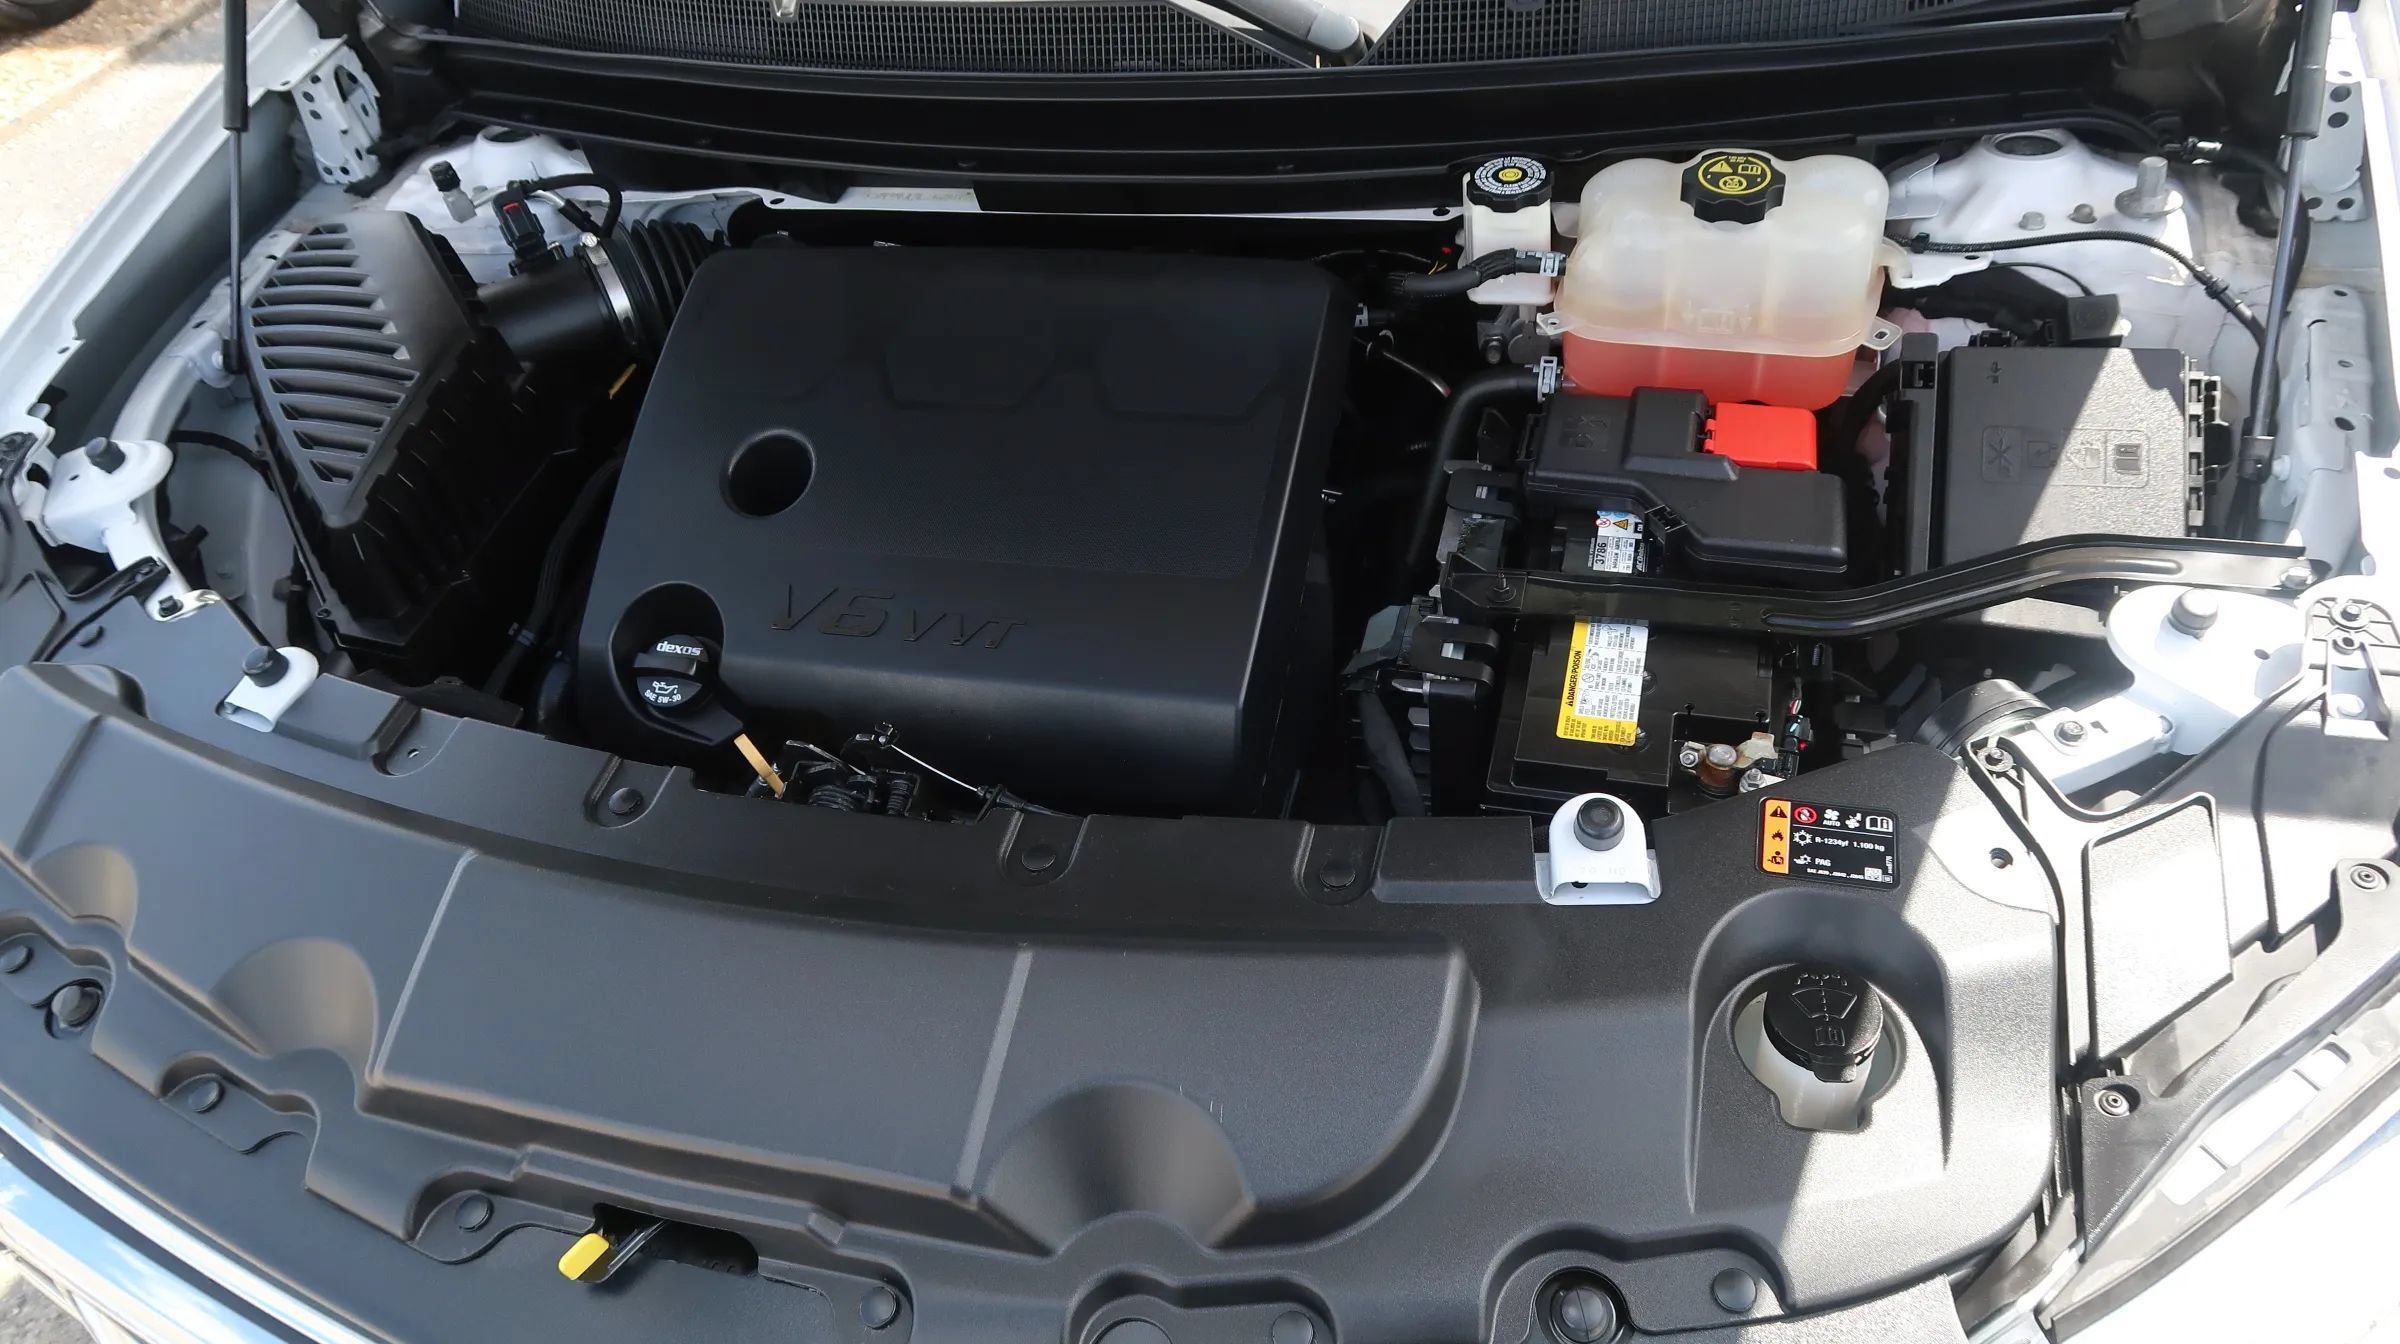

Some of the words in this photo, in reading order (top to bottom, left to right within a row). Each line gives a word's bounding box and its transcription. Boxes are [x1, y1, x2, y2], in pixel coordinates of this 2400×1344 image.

[1595, 542, 1607, 565] 3786
[769, 584, 896, 638] V6
[902, 608, 1029, 649] VVT
[656, 641, 703, 656] dexos
[1567, 650, 1582, 701] DANGER/POISON
[644, 690, 656, 702] SAE
[657, 694, 682, 703] 5W-30
[1815, 836, 1849, 847] R-1234yf
[1853, 841, 1873, 850] 1.100
[1874, 844, 1885, 852] kg
[1815, 857, 1831, 867] PAG
